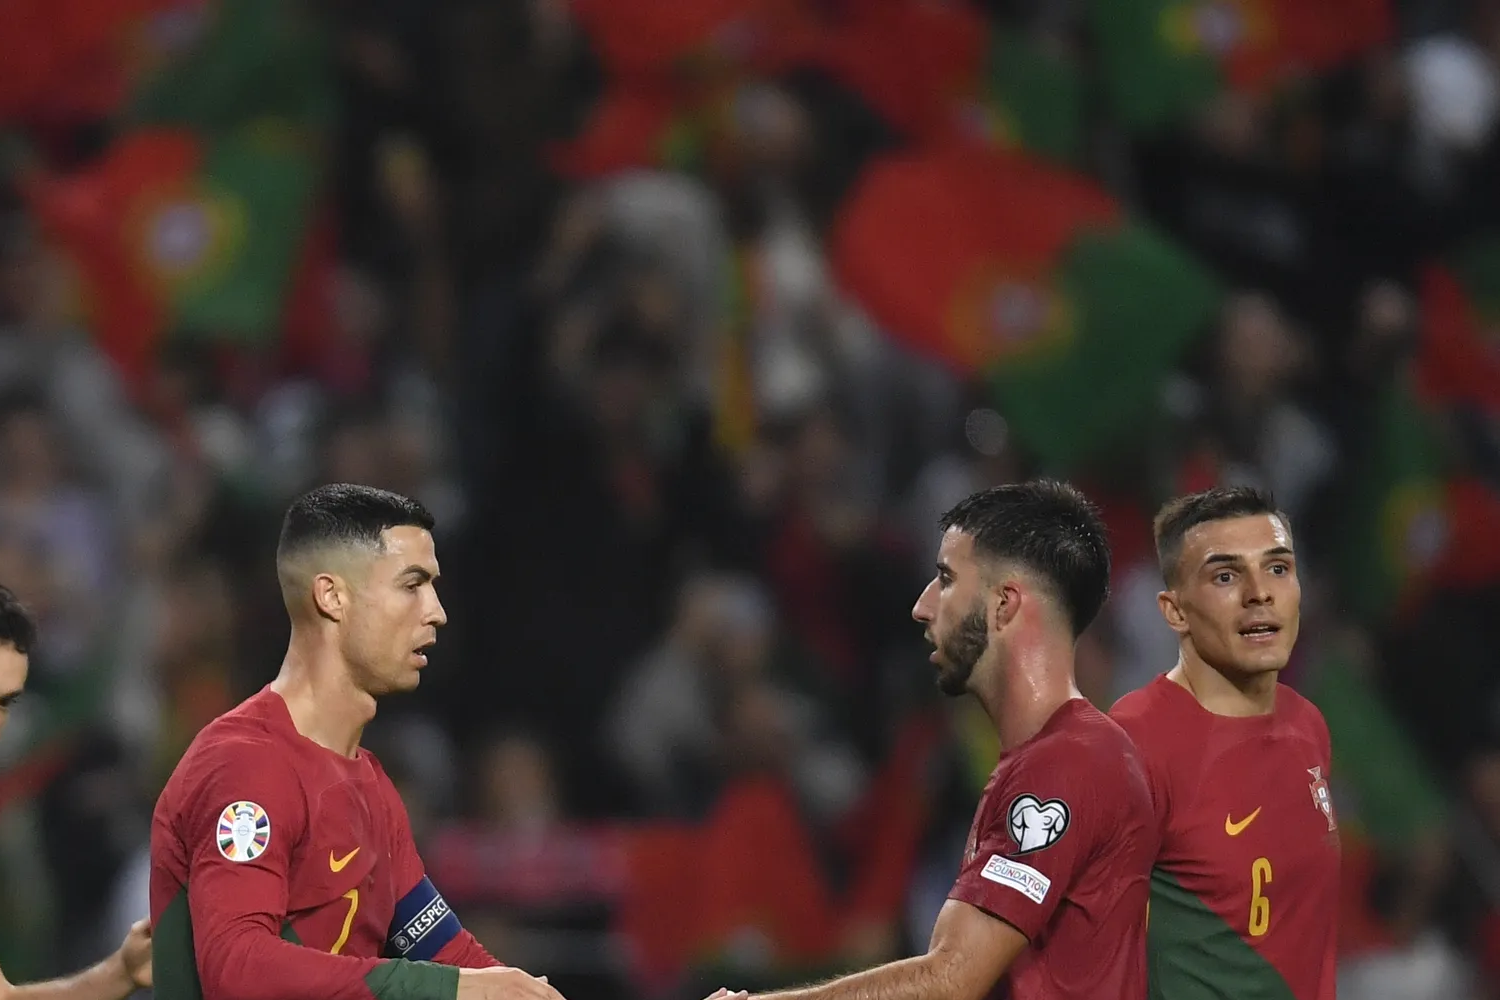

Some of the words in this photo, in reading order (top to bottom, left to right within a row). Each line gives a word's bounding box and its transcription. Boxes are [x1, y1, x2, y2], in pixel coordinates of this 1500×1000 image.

[987, 861, 1047, 896] FOUNDATION
[1248, 857, 1273, 937] 6
[331, 889, 360, 955] 7
